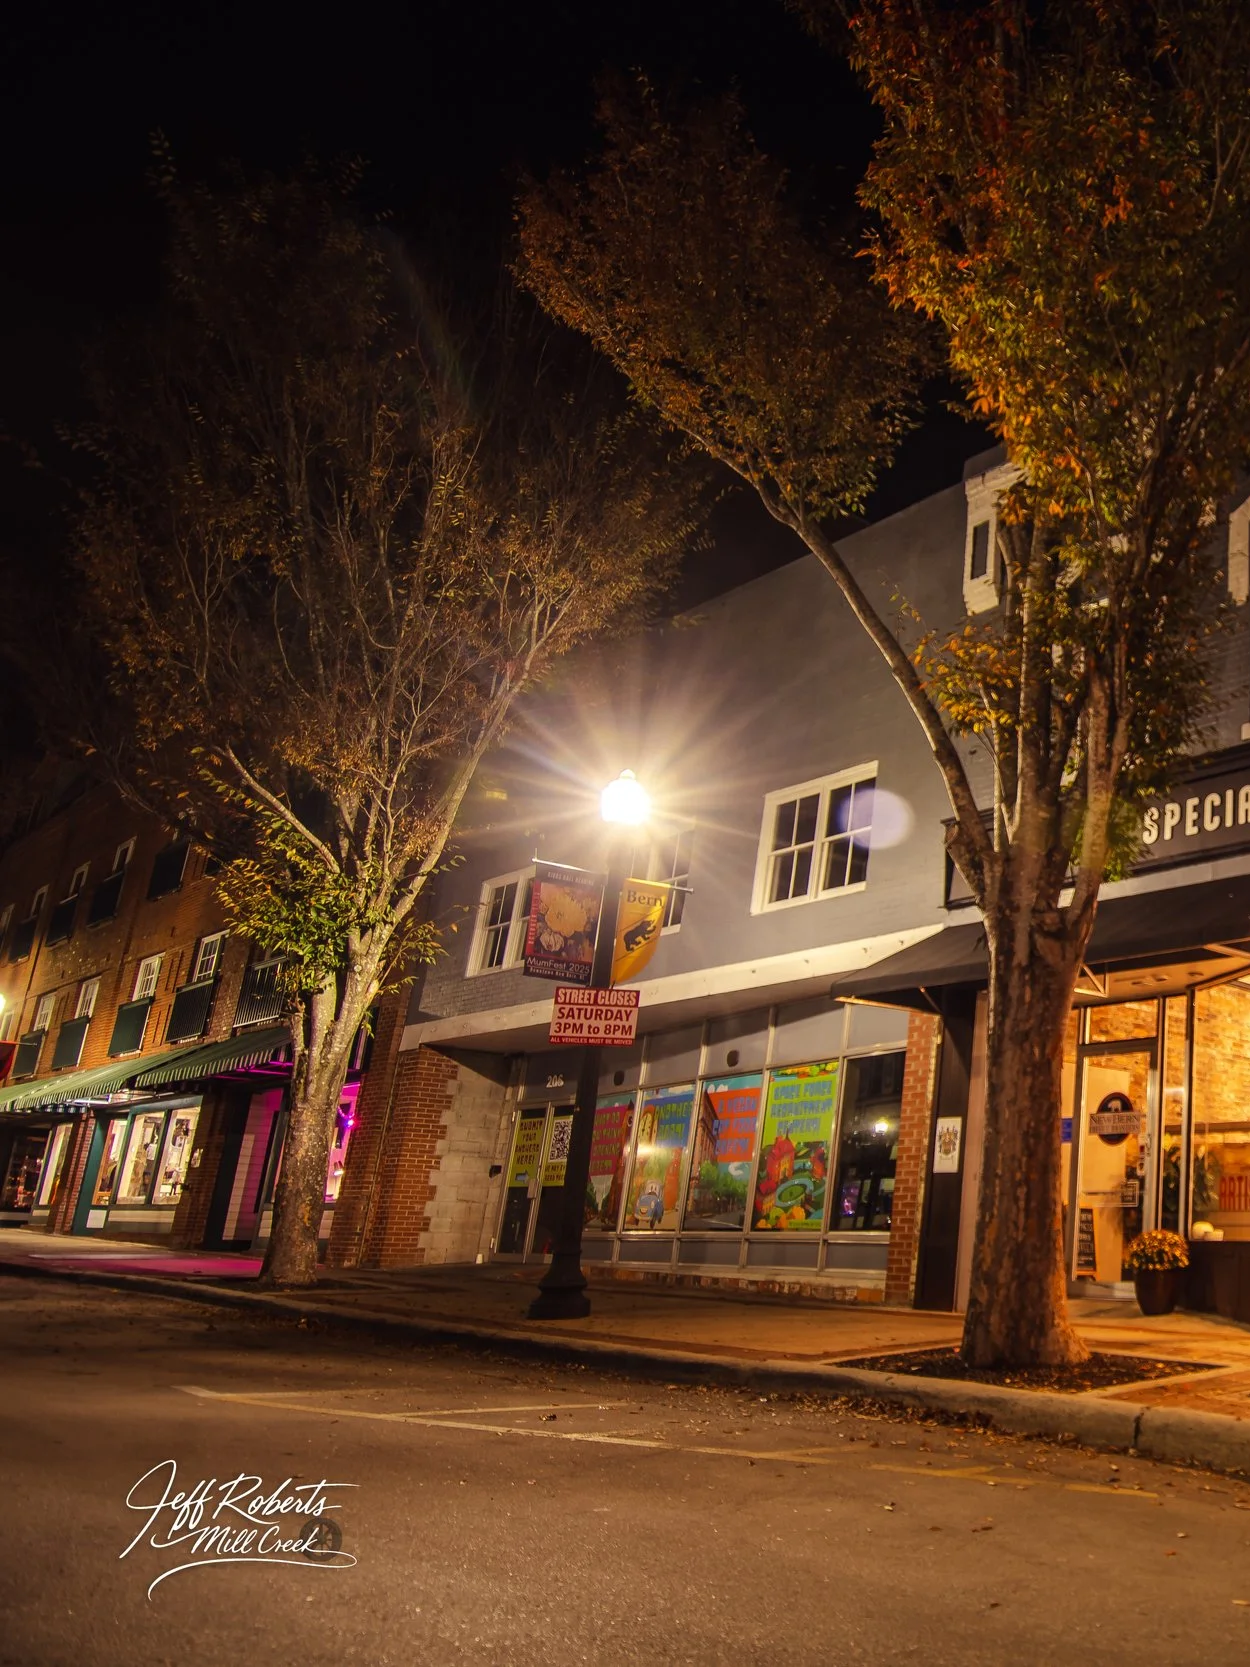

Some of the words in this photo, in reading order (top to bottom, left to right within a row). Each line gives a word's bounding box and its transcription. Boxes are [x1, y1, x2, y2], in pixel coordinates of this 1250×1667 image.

[626, 890, 665, 907] Bern
[527, 957, 566, 971] MumFest
[569, 963, 590, 974] 2025
[558, 988, 597, 1005] STREET
[597, 990, 637, 1006] CLOSES
[557, 1007, 633, 1022] SATURDAY
[554, 1022, 584, 1035] 3PM
[588, 1024, 600, 1035] to
[604, 1024, 633, 1036] 8PM
